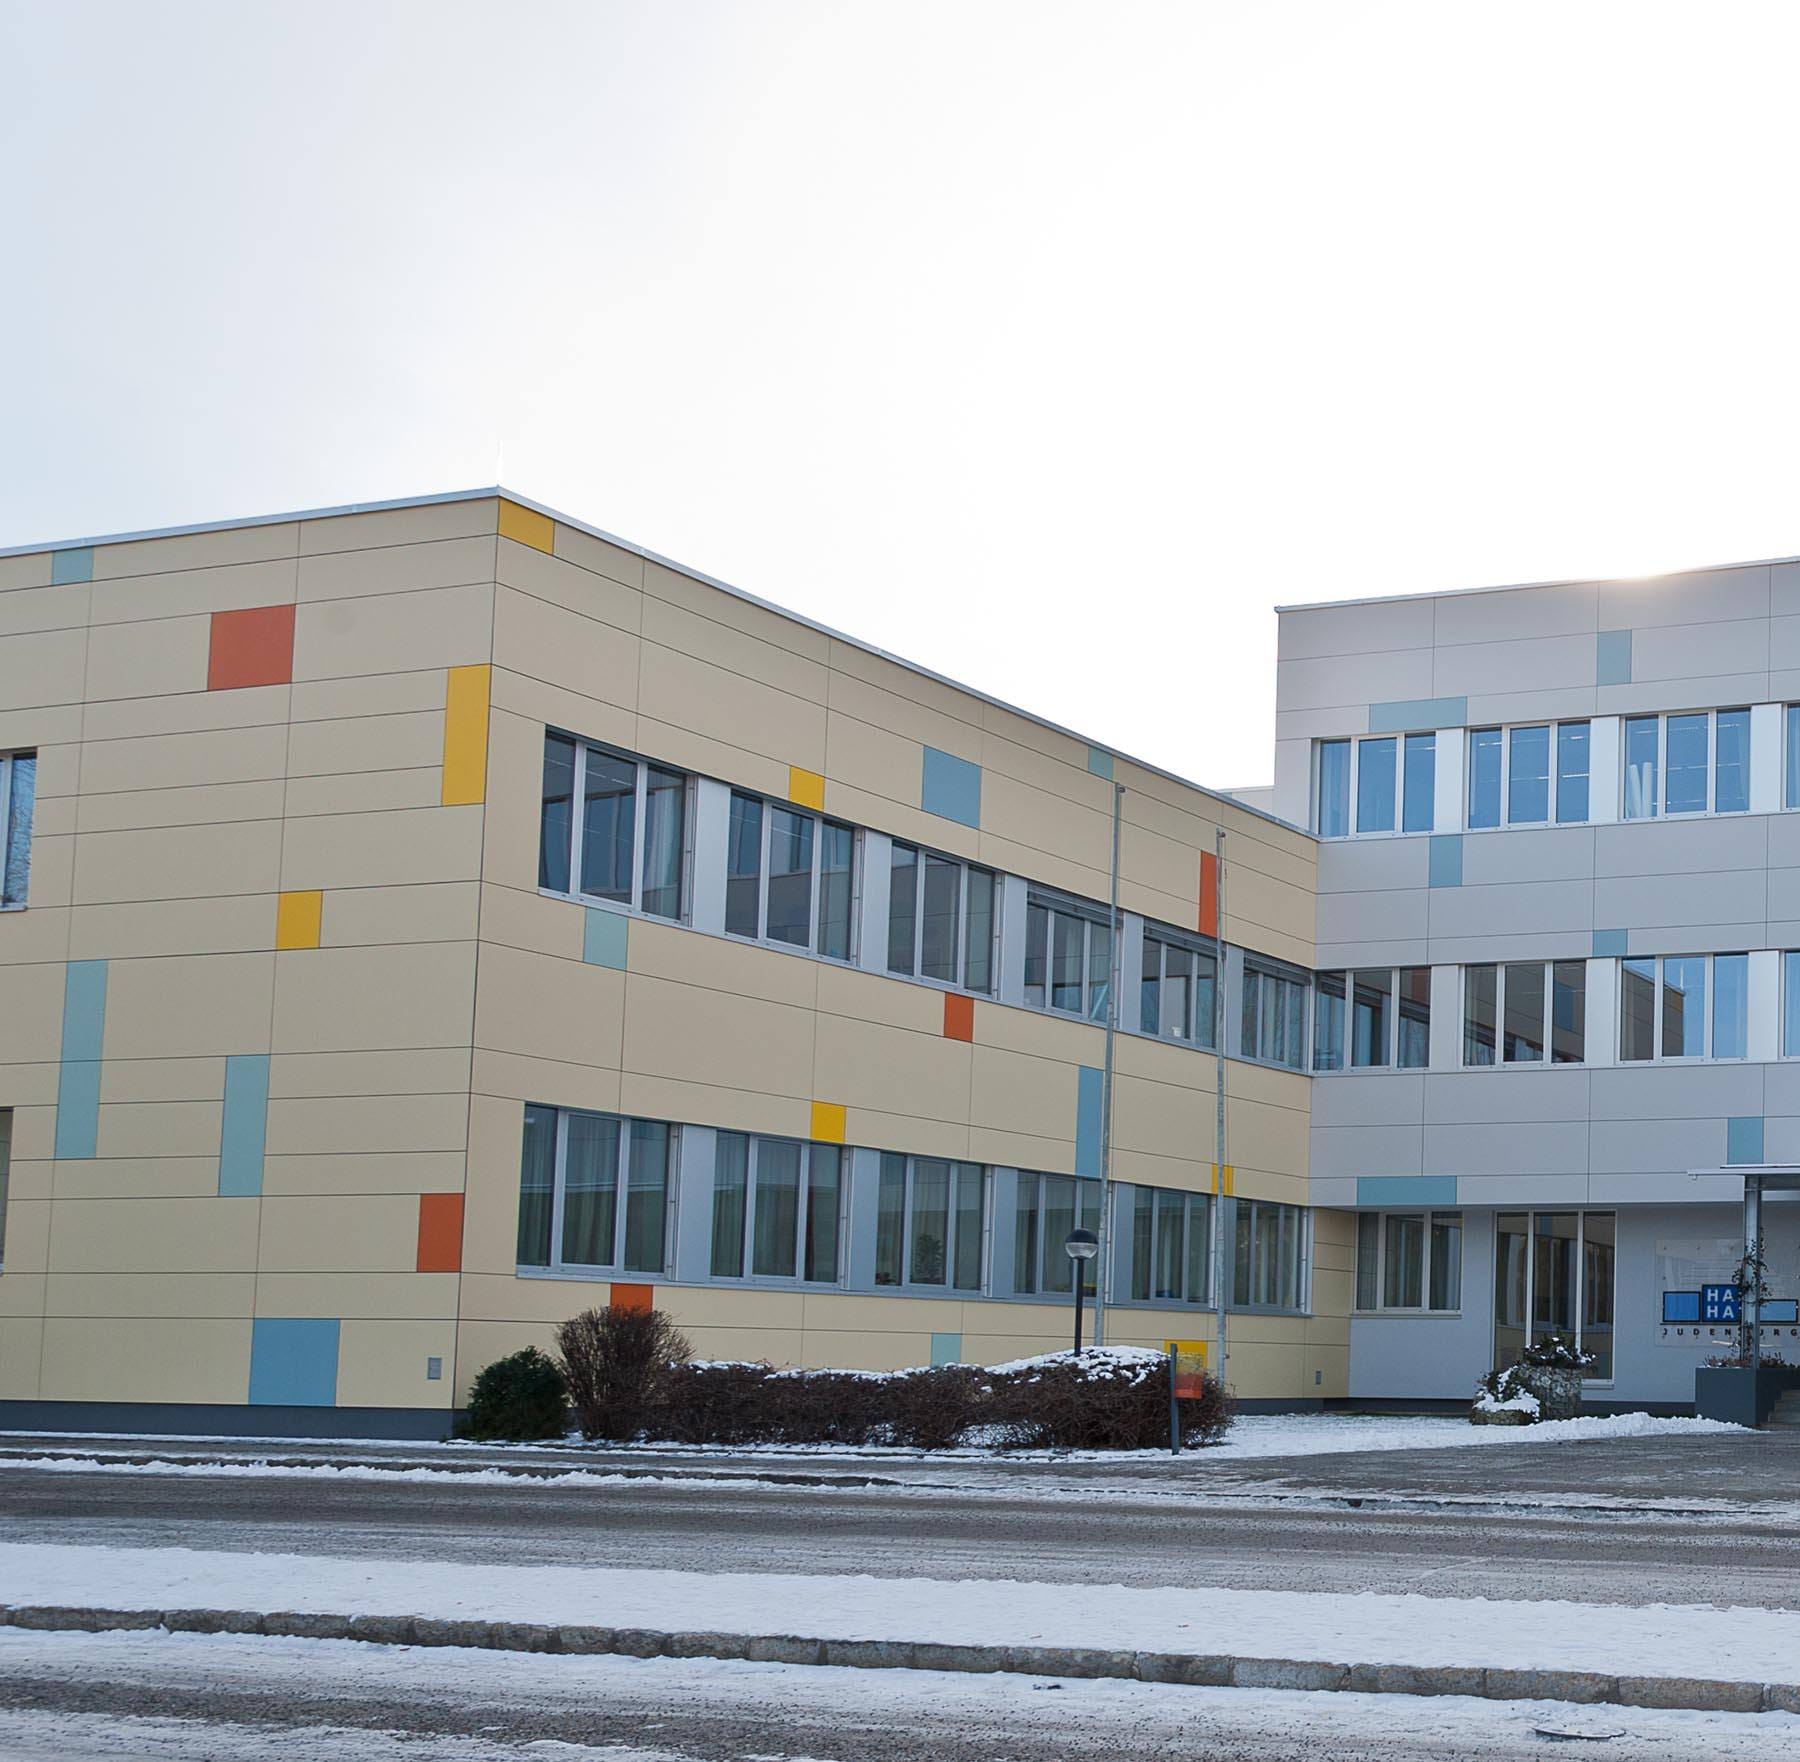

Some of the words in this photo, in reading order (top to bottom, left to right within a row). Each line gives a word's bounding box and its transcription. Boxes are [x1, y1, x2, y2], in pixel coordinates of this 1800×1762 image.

[1706, 1289, 1742, 1302] HA
[1706, 1305, 1742, 1319] HA
[1663, 1327, 1798, 1336] JUDENURG
